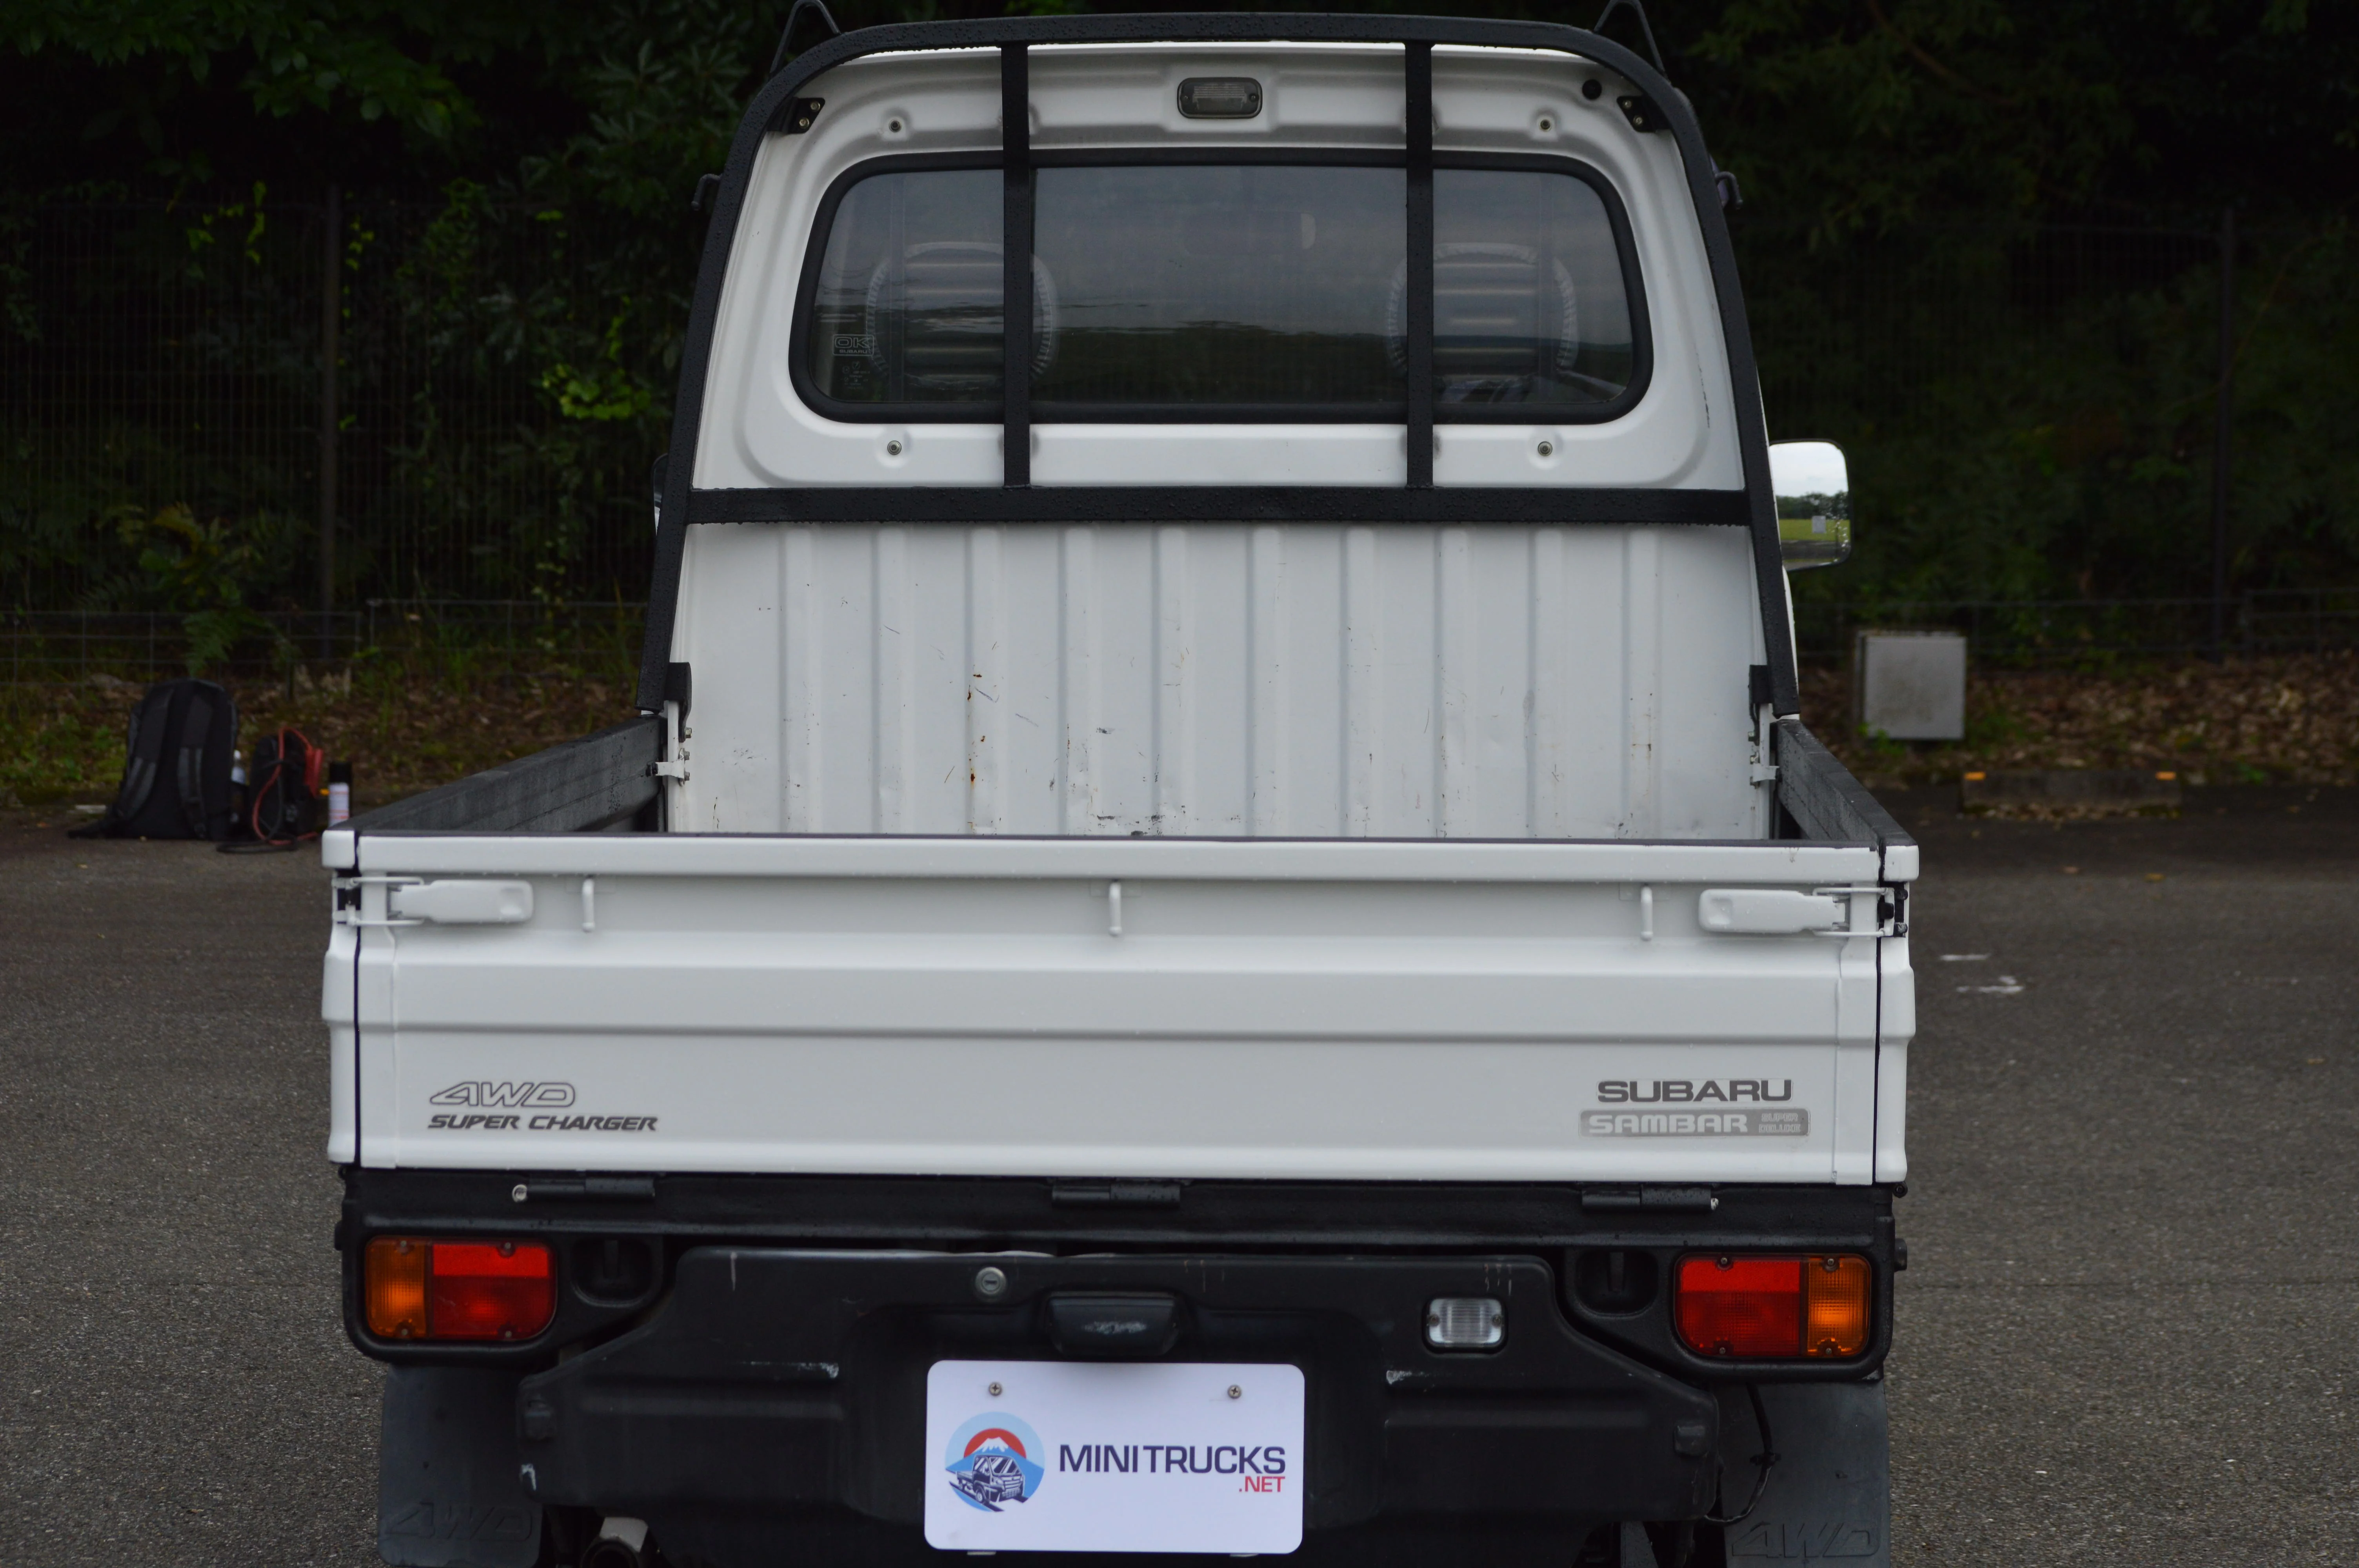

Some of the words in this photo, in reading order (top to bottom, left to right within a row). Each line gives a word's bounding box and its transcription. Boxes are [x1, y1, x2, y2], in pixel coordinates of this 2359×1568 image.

[429, 1082, 576, 1108] 4WD
[1598, 1079, 1792, 1103] SUBARU
[428, 1114, 520, 1130] SUPER
[528, 1115, 658, 1132] CHARGER
[1588, 1114, 1748, 1134] SAMBAR
[1761, 1112, 1798, 1123] SUPER
[1758, 1123, 1801, 1134] DELUXE
[1059, 1444, 1286, 1475] MINITRUCKS
[1238, 1475, 1285, 1493] .NET
